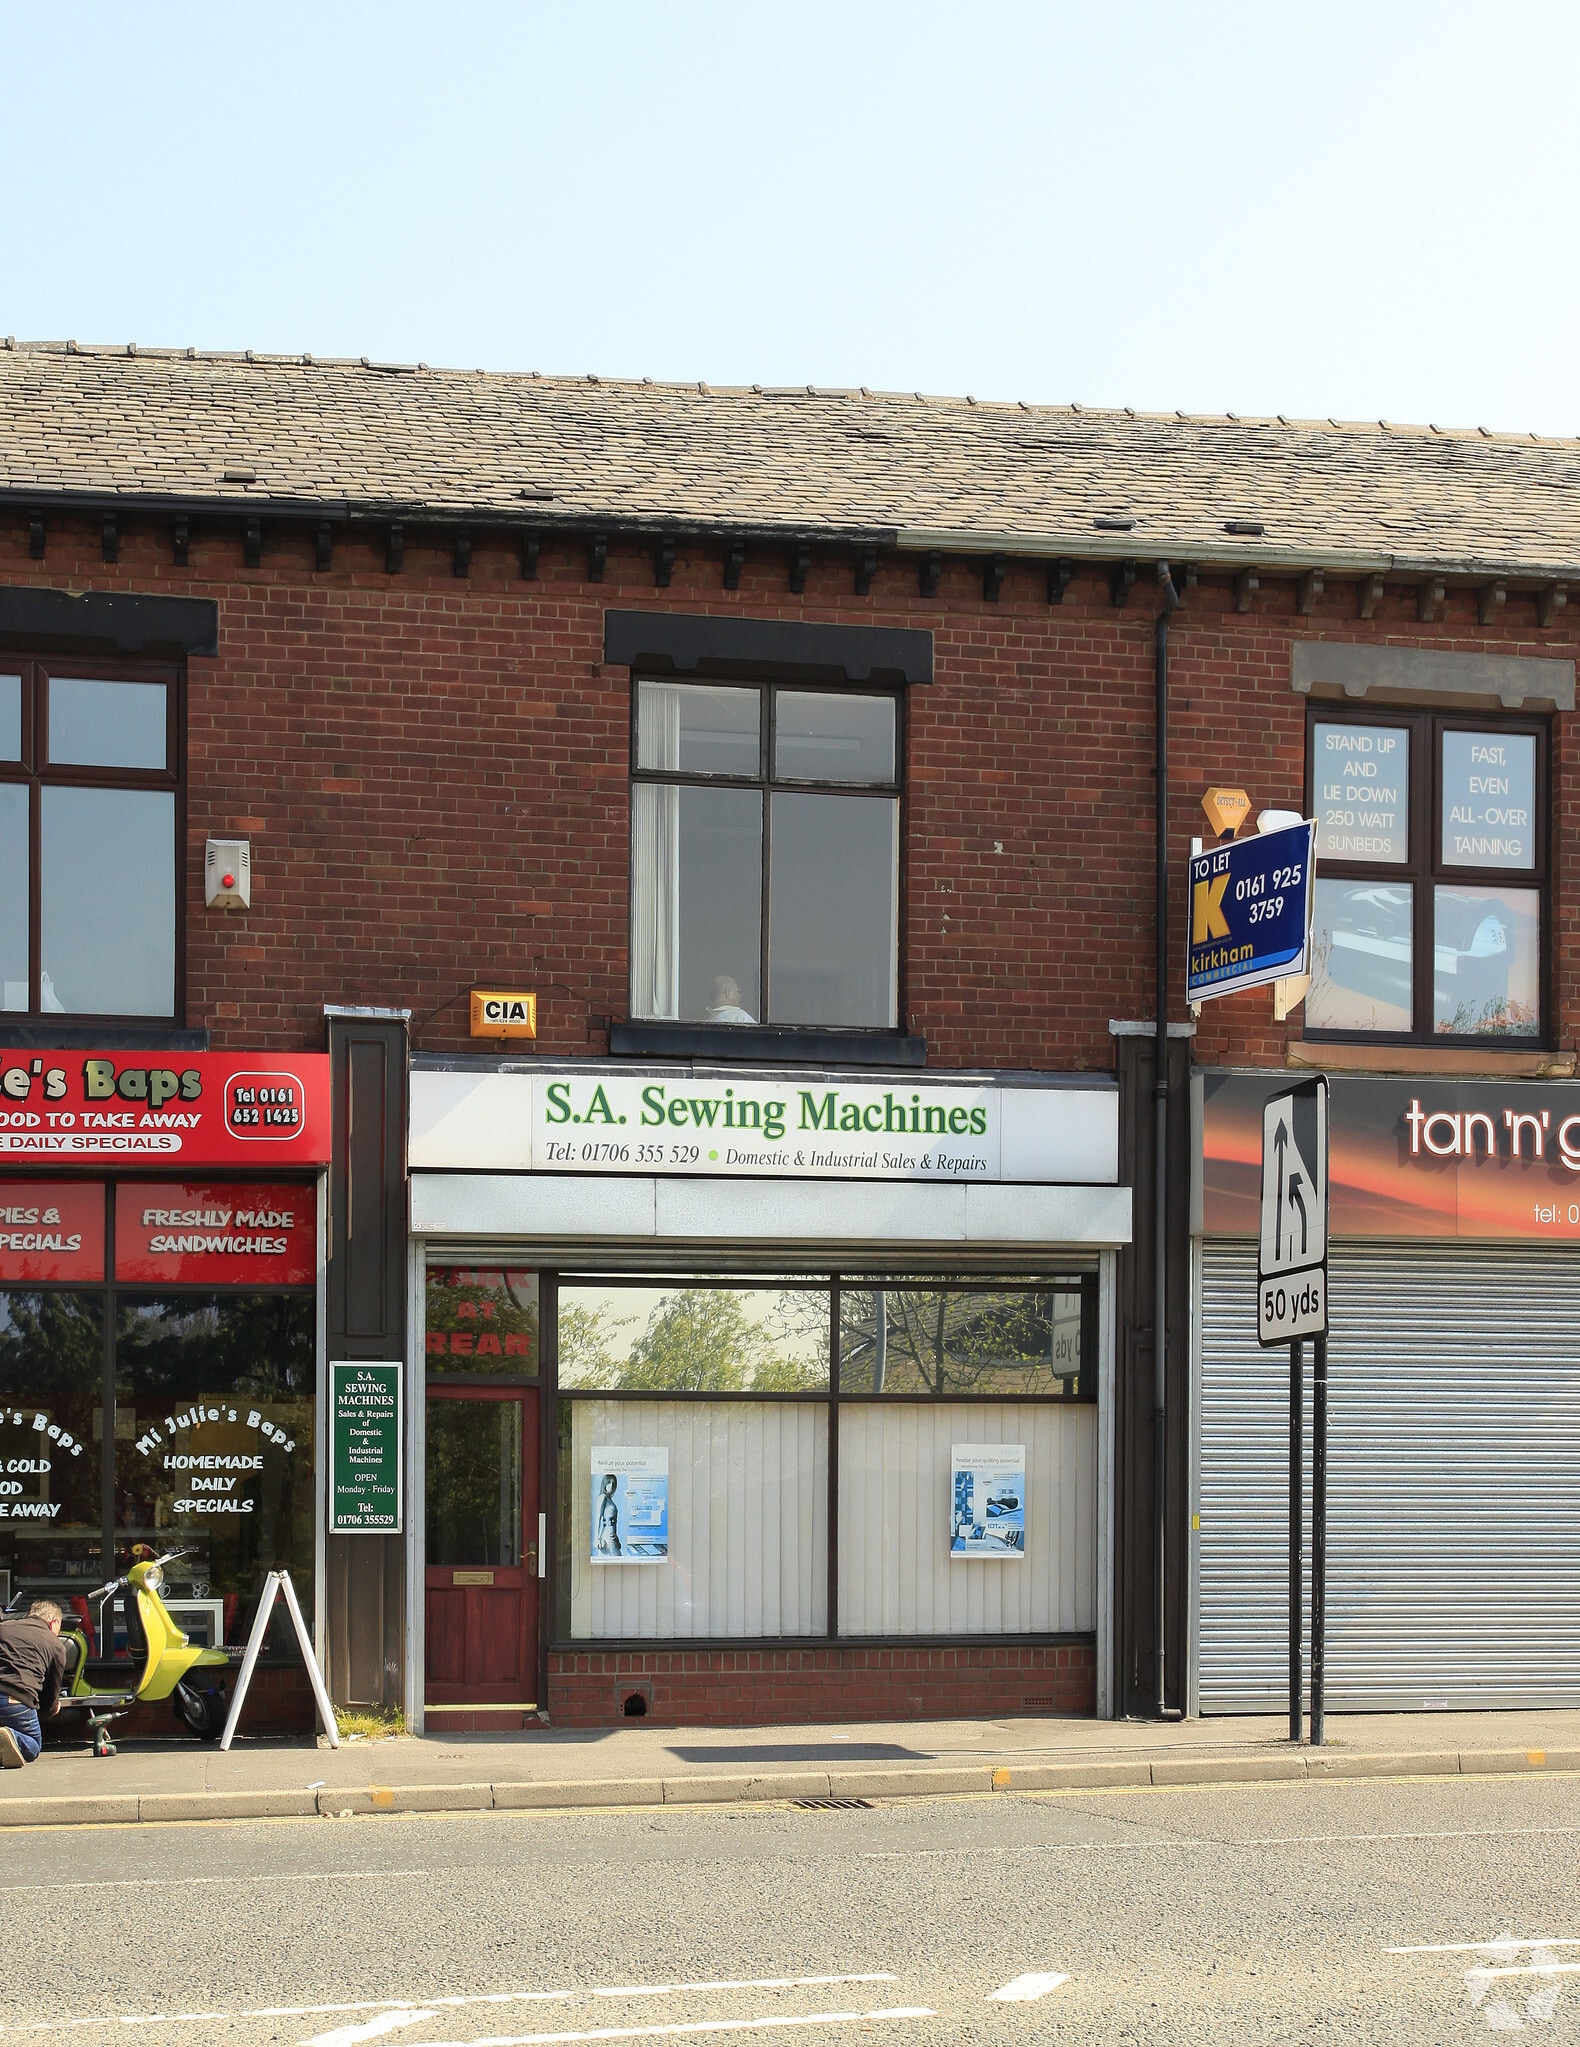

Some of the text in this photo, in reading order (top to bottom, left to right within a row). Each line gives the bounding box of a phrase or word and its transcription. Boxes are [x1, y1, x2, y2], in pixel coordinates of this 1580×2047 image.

[1326, 735, 1395, 753] STAND UP
[1471, 746, 1506, 766] FAST,
[1343, 761, 1377, 777] AND
[1324, 785, 1396, 803] LIE DOWN
[1469, 776, 1508, 795] EVEN
[1326, 810, 1395, 828] 250 WATT
[1328, 836, 1391, 853] SUNBEDS
[1455, 837, 1522, 856] TANNING
[1194, 852, 1231, 879] TO LET
[1235, 864, 1302, 900] 0161 925
[1192, 872, 1231, 945] K
[1249, 896, 1284, 924] 3759
[1191, 943, 1254, 974] kirkham
[1191, 959, 1254, 985] COMMERCIAL
[486, 1001, 526, 1020] CIA
[83, 1059, 202, 1107] Baps
[236, 1087, 294, 1104] Tel 0161
[45, 1112, 76, 1128] TO
[80, 1112, 135, 1129] TAKE
[139, 1113, 203, 1129] AWAY
[232, 1108, 300, 1125] 652 1425
[545, 1082, 988, 1141] S.A. Sewing Machines
[1405, 1099, 1495, 1156] tan
[9, 1136, 67, 1149] DAILY
[71, 1137, 172, 1149] SPECIALS
[545, 1142, 699, 1165] Tel: 01706 355 529
[726, 1148, 987, 1175] Domestic & Industrial Sales & Repairs
[42, 1207, 61, 1224] &
[142, 1209, 295, 1229] FRESHLY MADE
[1534, 1204, 1580, 1224] tel: 0
[149, 1235, 288, 1254] SANDWICHES
[457, 1301, 497, 1319] AT
[1264, 1283, 1319, 1324] 50 yds
[426, 1332, 531, 1356] REAR
[357, 1371, 375, 1381] S.A.
[345, 1383, 387, 1393] SEWING
[338, 1395, 394, 1405] MACHINES
[338, 1410, 394, 1420] Sales & Repairs
[362, 1419, 370, 1427] of
[32, 1413, 83, 1456] Baps
[136, 1405, 296, 1456] Mi Julie's Baps
[349, 1428, 382, 1436] Domestic
[349, 1447, 383, 1455] Industrial
[349, 1456, 382, 1464] Machines
[7, 1459, 51, 1473] COLD
[163, 1455, 264, 1470] HOMEMADE
[191, 1477, 237, 1491] DAILY
[354, 1473, 378, 1482] OPEN
[337, 1486, 366, 1495] Monday
[372, 1485, 395, 1495] Friday
[11, 1503, 61, 1517] AWAY
[172, 1499, 254, 1513] SPECIALS
[358, 1503, 373, 1512] Tel:
[337, 1515, 394, 1525] 01706 355529
